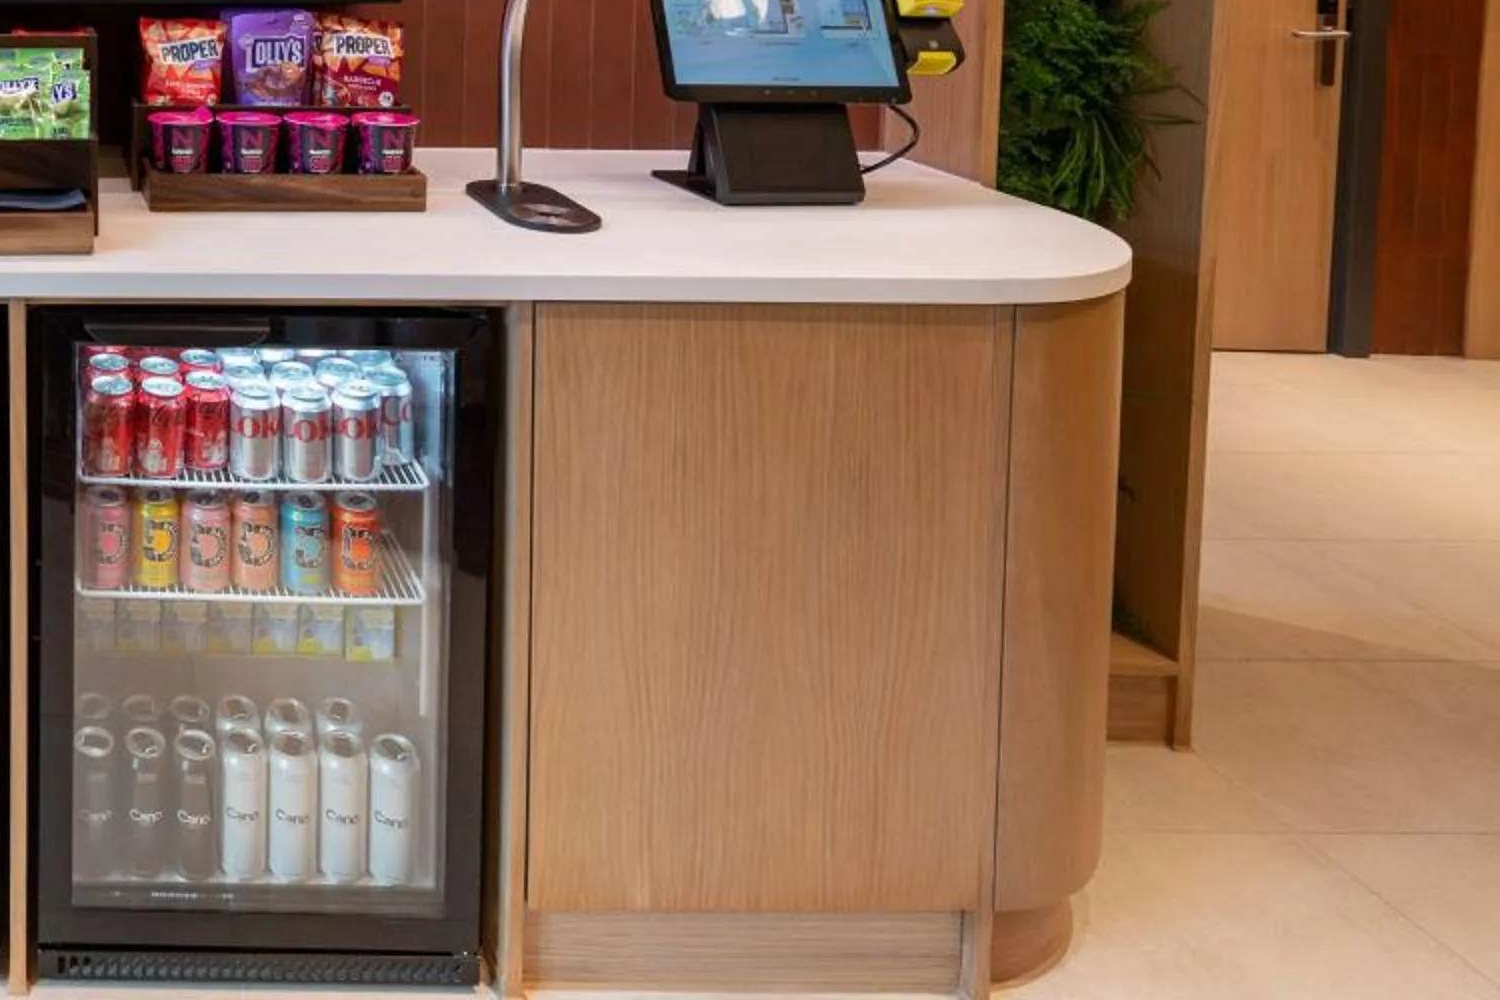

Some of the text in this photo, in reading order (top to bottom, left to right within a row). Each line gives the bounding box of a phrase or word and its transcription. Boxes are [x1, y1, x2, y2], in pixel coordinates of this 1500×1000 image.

[161, 40, 219, 62] PROPER
[255, 41, 301, 64] OLLY'S
[336, 35, 391, 55] PROPER
